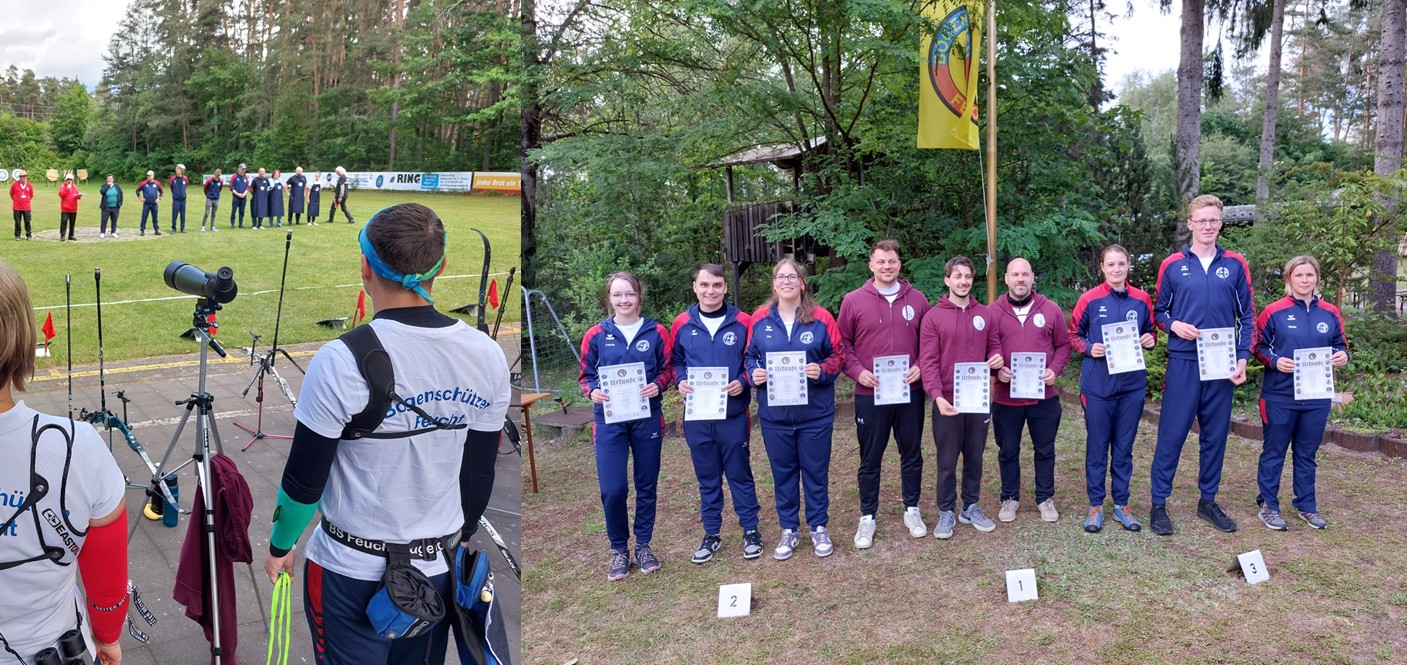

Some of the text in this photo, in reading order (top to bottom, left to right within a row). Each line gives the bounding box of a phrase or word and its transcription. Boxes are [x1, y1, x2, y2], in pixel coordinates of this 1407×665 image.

[397, 174, 421, 184] RING
[492, 179, 505, 187] Brot
[329, 522, 344, 539] BS
[1249, 562, 1258, 575] 3
[1018, 579, 1023, 592] 1
[729, 595, 738, 608] 2
